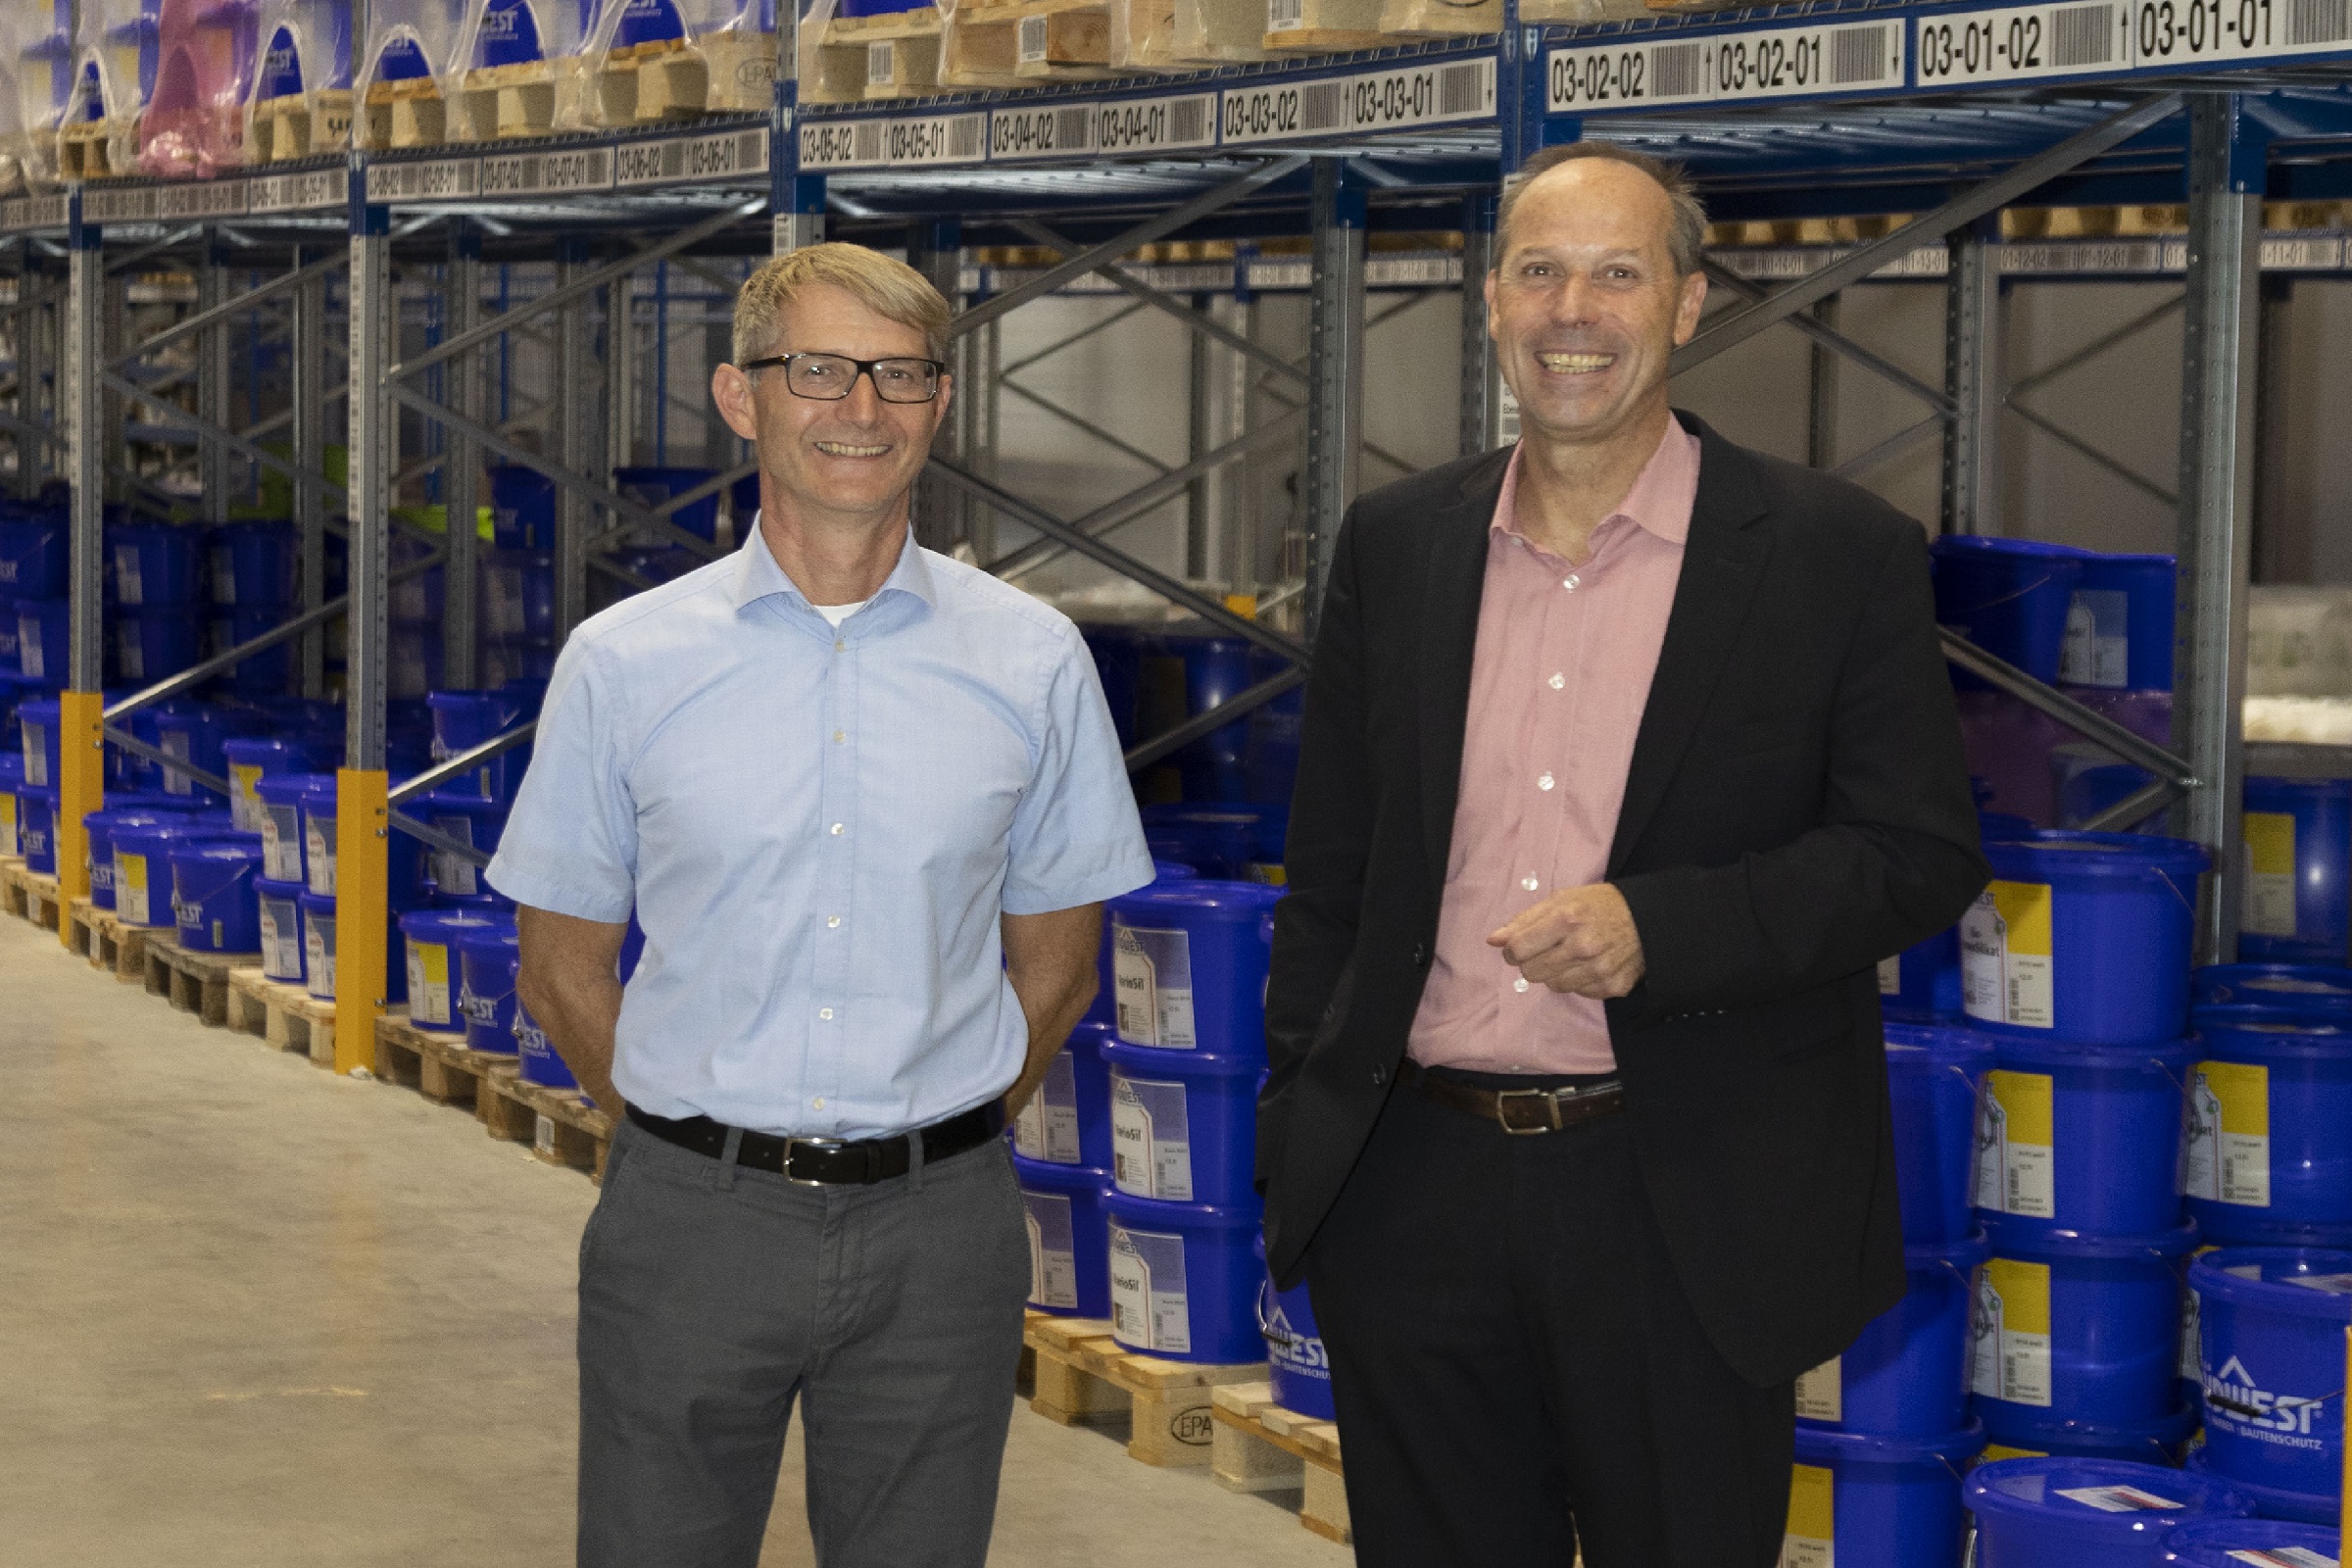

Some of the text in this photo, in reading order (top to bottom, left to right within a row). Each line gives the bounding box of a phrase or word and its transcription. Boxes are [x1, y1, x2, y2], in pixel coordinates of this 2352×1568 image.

[1922, 15, 2041, 76] 03-01-02
[2140, 0, 2272, 57] 03-01-01
[1552, 50, 1645, 103] 03-02-02
[1719, 33, 1821, 91] 03-02-01
[1225, 89, 1298, 136] 03-03-02
[1355, 72, 1434, 123] 03-03-01
[802, 126, 853, 163] 03-05-02
[891, 120, 945, 161] 03-05-01
[993, 111, 1054, 152] 03-04-02
[1101, 104, 1166, 148] 03-04-01
[484, 160, 520, 189] 03-07-02
[547, 153, 586, 186] 03-07-01
[618, 145, 661, 180] 03-06-02
[692, 137, 735, 174] 03-06-01
[2262, 243, 2303, 264] 1-11-01
[1180, 1414, 1213, 1439] EPA
[2239, 1425, 2324, 1450] BAUTENSCHUTZ
